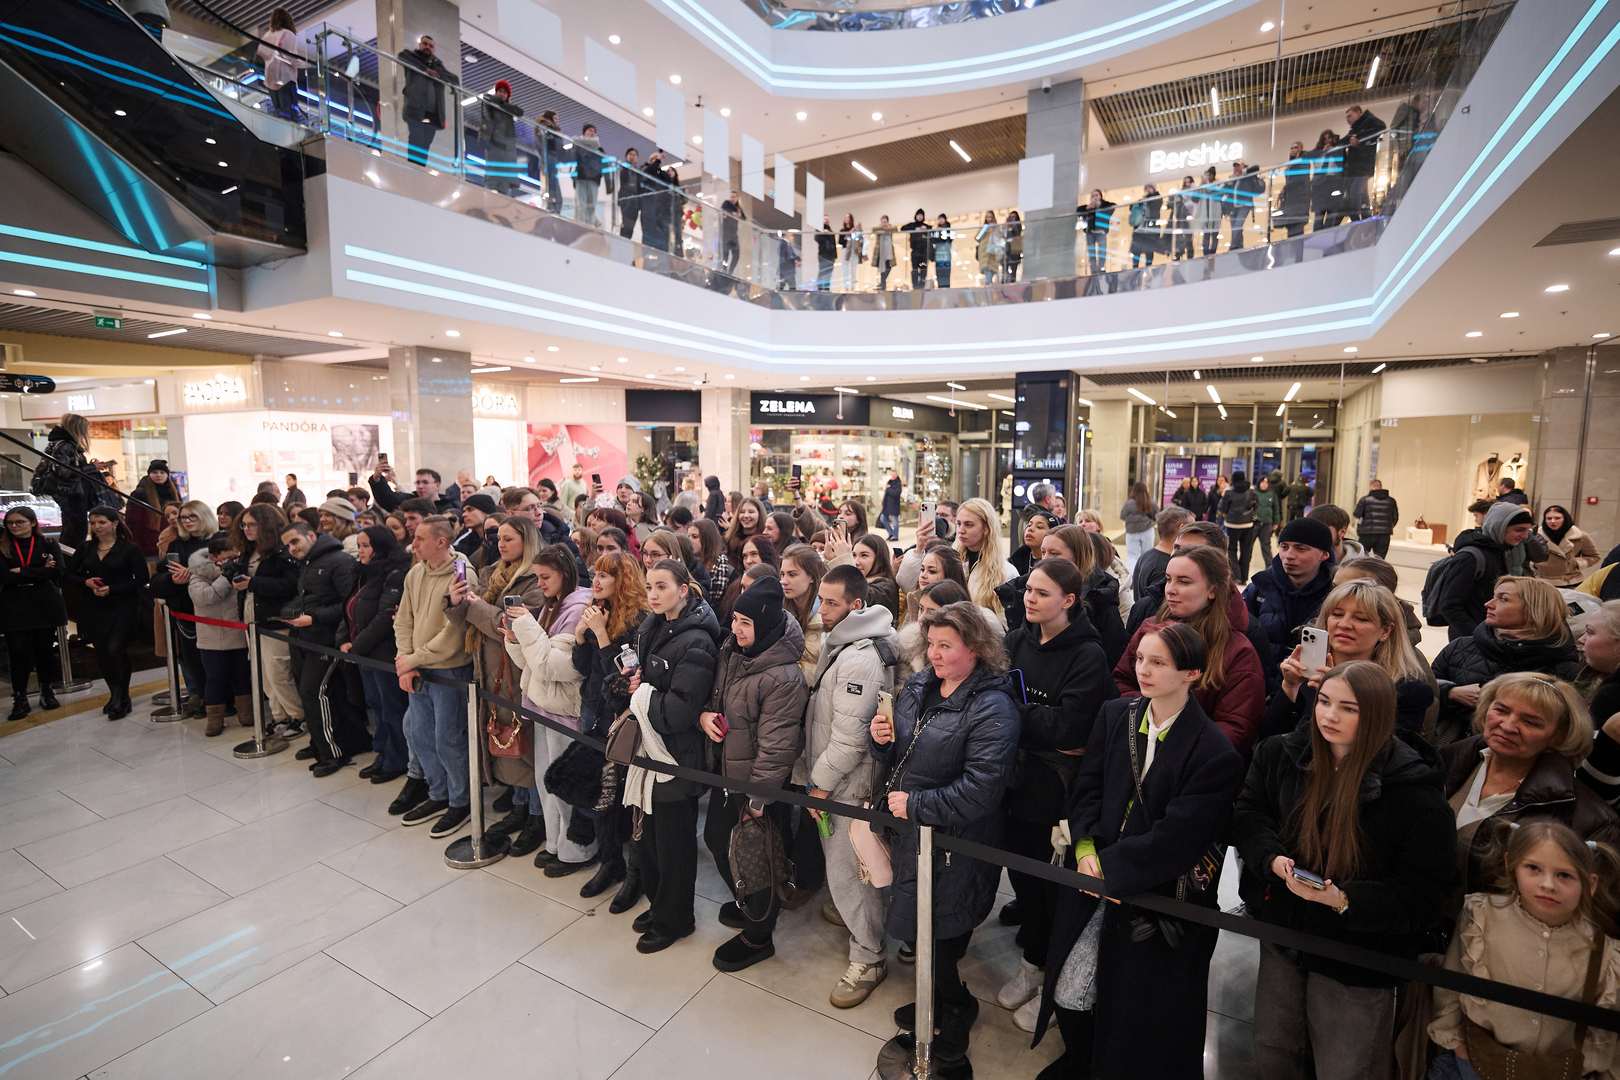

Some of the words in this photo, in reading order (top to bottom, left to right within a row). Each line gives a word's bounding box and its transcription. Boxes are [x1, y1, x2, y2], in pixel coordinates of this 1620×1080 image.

[1149, 140, 1243, 174] Bershka
[184, 376, 247, 405] PANDORA
[472, 393, 519, 413] DORA
[759, 400, 816, 413] ZELENA
